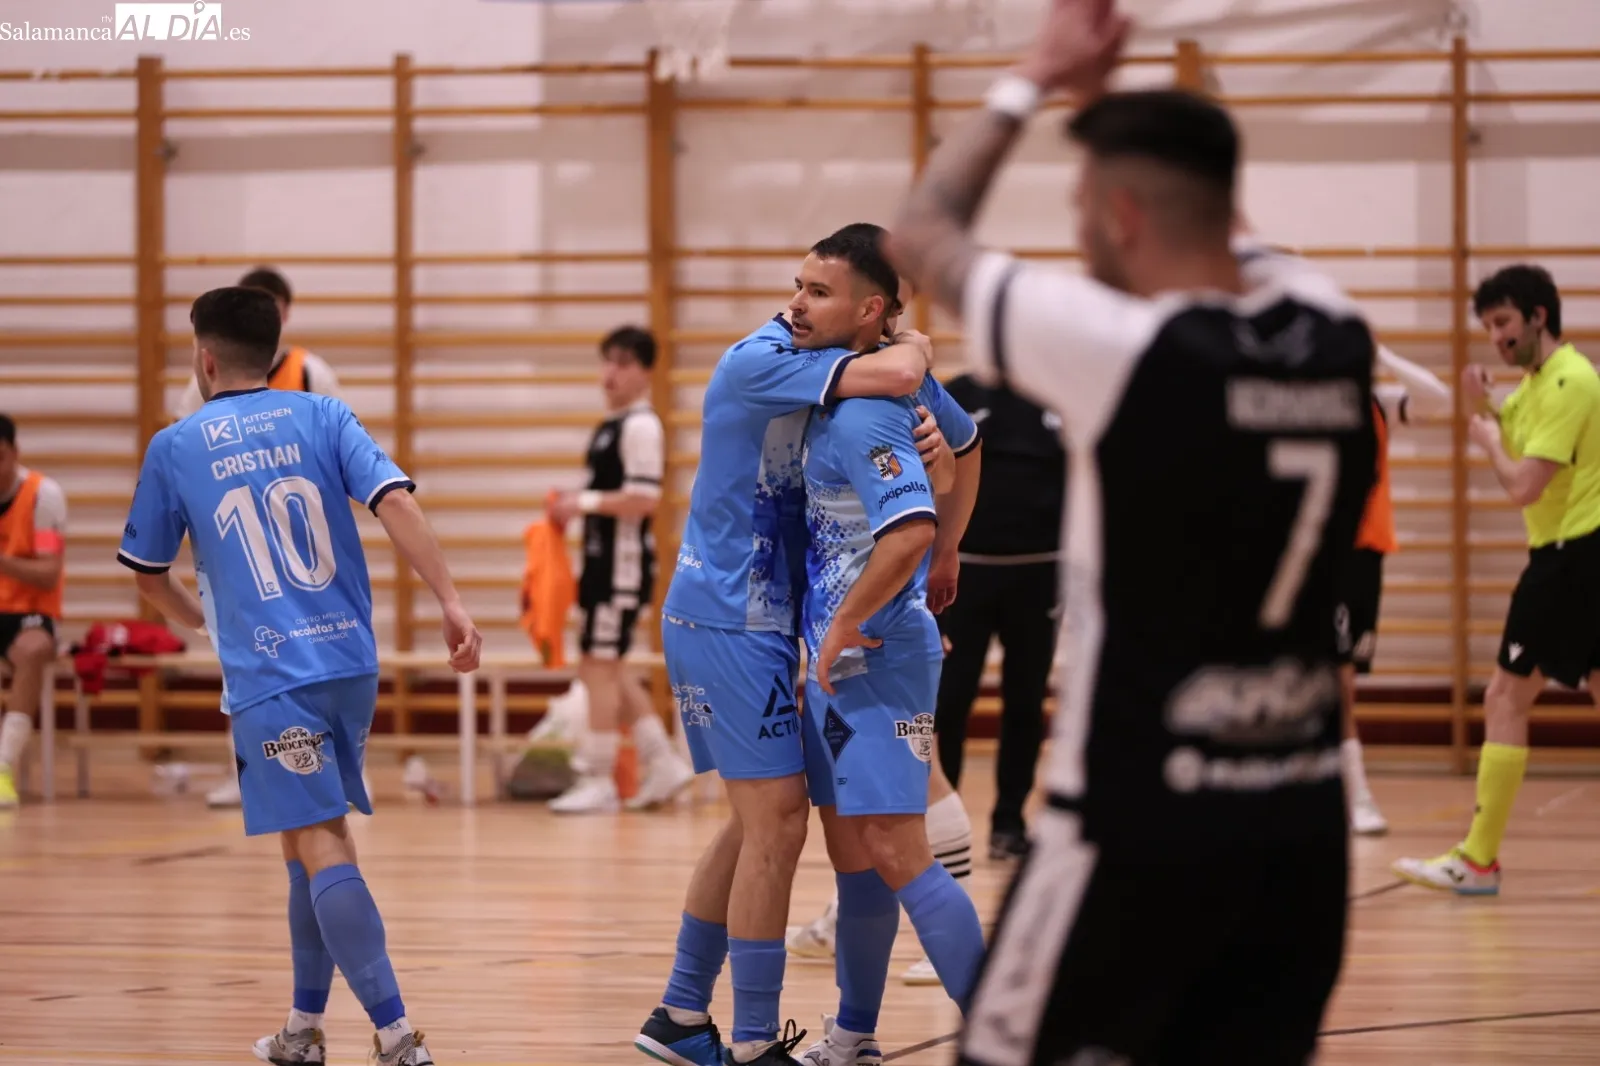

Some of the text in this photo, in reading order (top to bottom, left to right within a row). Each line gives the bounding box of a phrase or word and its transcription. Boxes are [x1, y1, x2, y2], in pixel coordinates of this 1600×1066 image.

[242, 407, 292, 425] KITCHEN
[245, 422, 276, 435] PLUS
[210, 443, 301, 481] CRISTIAN
[213, 475, 337, 601] 10
[1257, 438, 1341, 630] 7
[289, 618, 358, 639] recoletas salud
